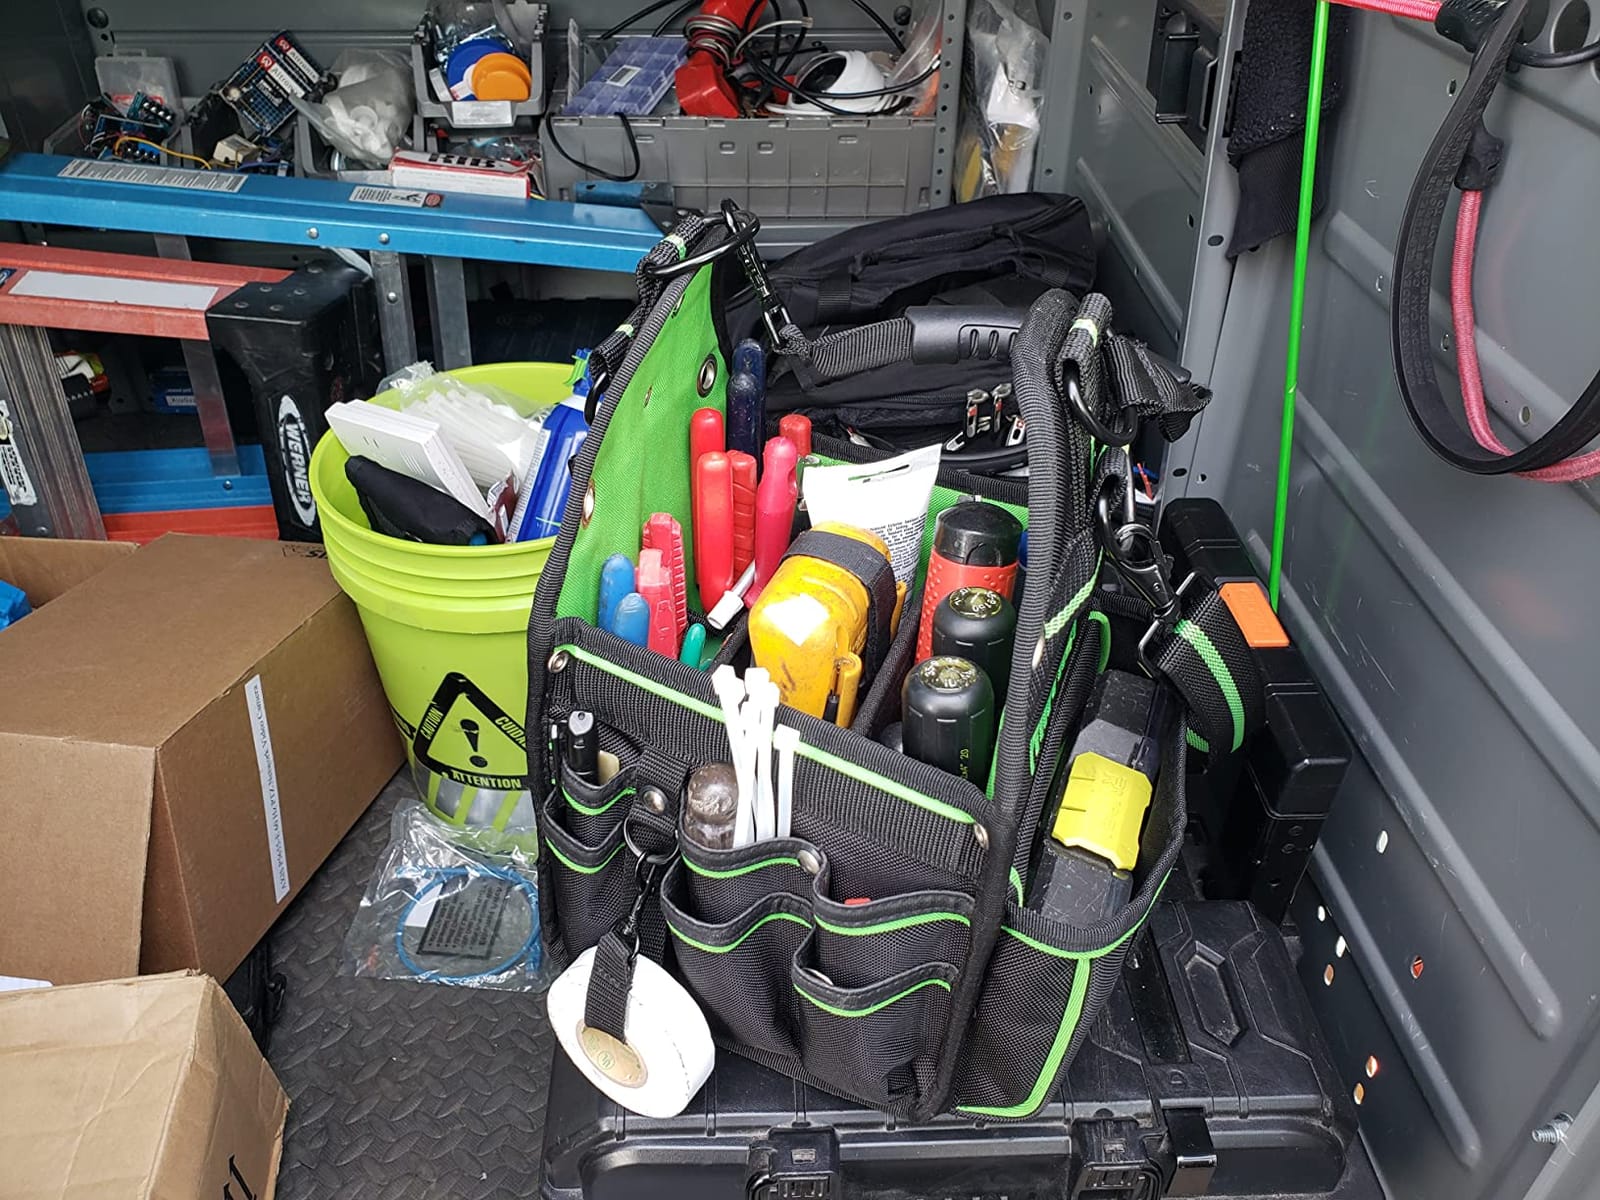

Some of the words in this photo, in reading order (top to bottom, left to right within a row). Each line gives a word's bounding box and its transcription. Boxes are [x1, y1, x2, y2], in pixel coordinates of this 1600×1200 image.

[286, 423, 312, 504] WERNER
[253, 684, 263, 720] Camera
[259, 720, 268, 748] Video
[420, 707, 444, 740] CAUTION
[452, 770, 522, 789] ATTENTION
